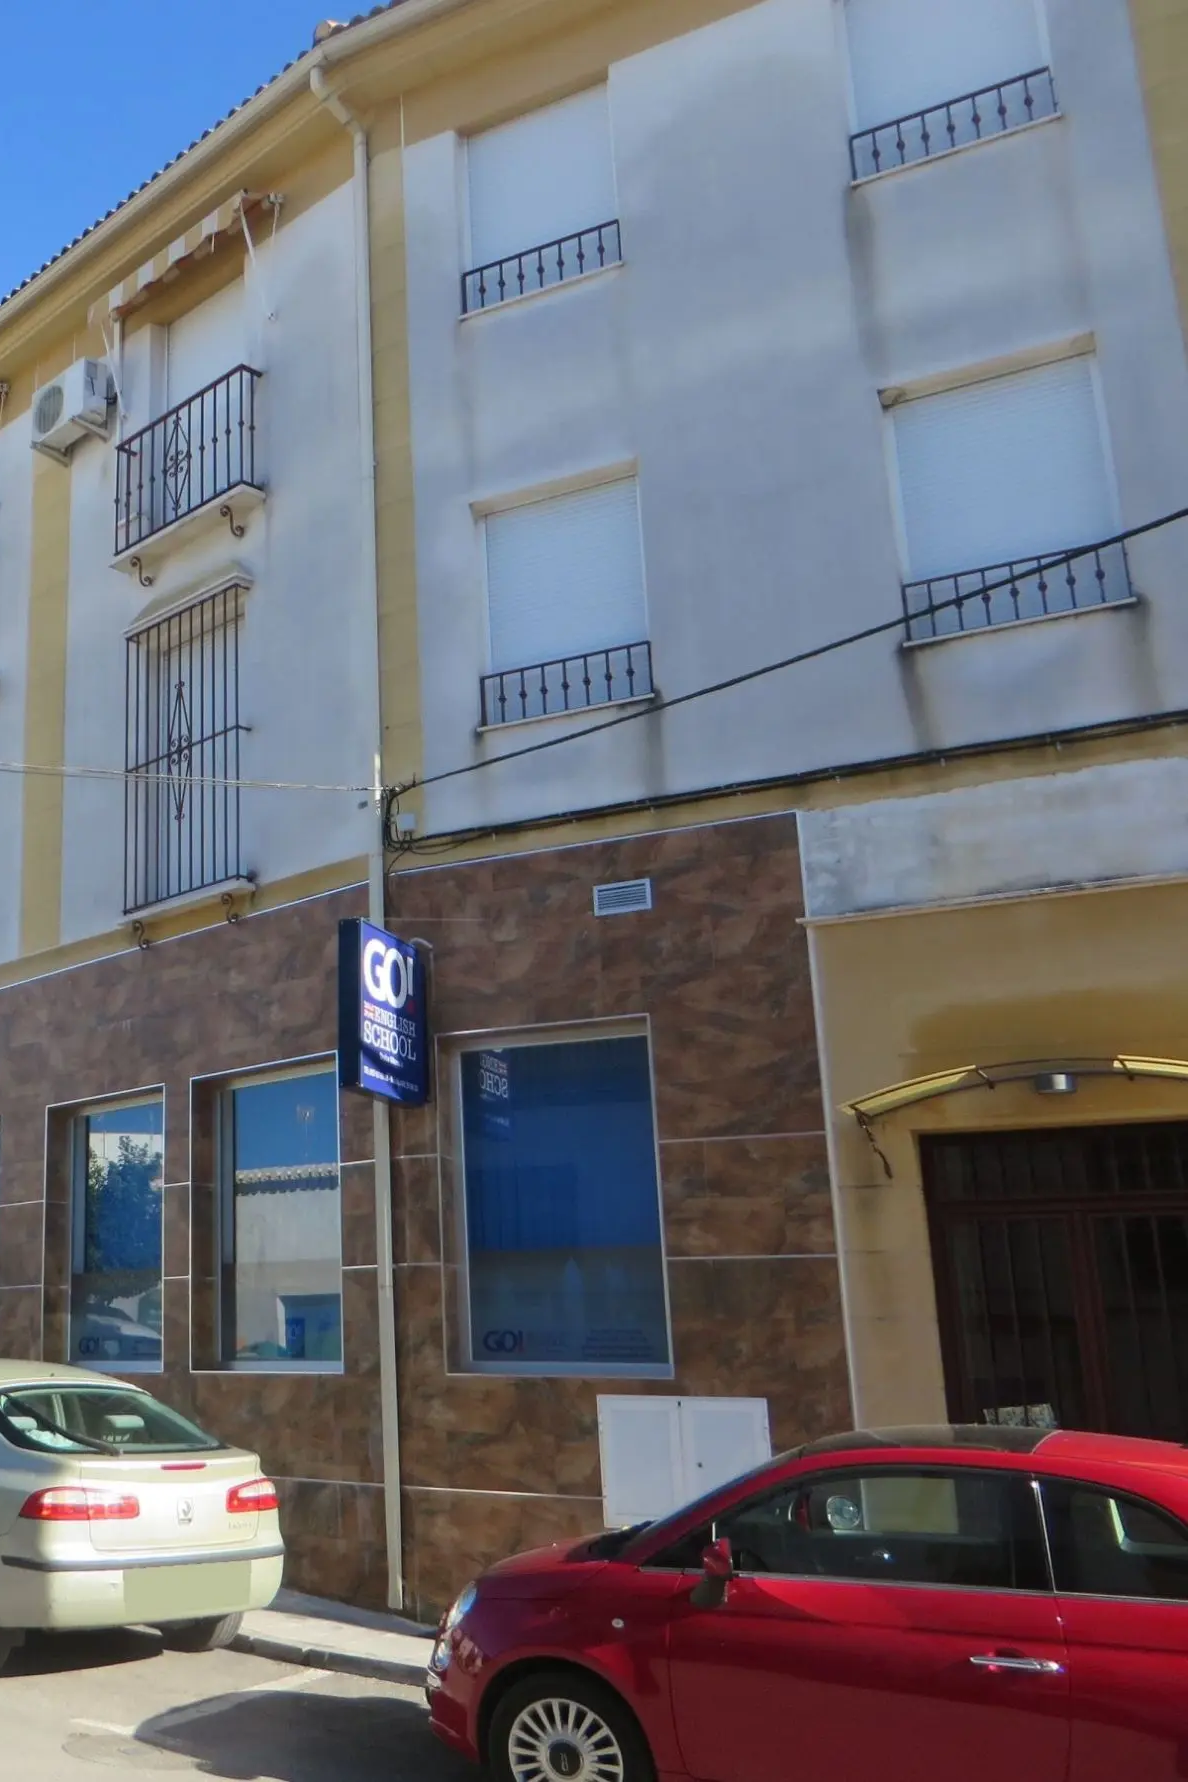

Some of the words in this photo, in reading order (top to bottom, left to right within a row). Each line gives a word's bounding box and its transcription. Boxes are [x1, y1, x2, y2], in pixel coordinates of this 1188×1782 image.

[363, 938, 416, 1015] GO!
[363, 1020, 416, 1060] SCHOOL
[374, 1006, 416, 1038] ENGLISH
[483, 1329, 524, 1353] GO!
